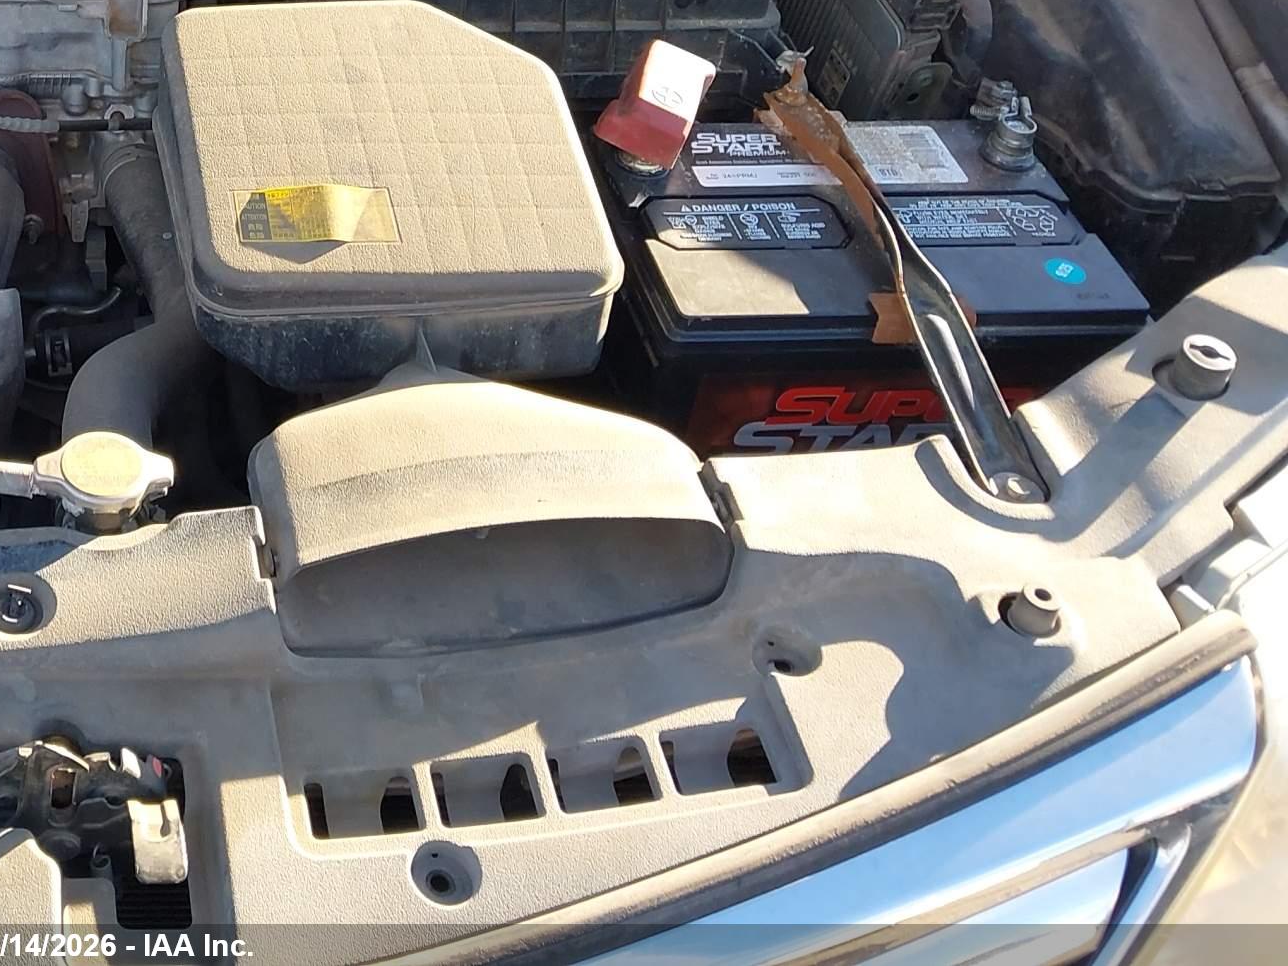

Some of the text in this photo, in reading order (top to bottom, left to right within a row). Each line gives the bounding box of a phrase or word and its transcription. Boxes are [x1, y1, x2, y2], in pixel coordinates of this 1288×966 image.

[696, 132, 777, 143] SUPER
[691, 141, 781, 153] START
[692, 203, 740, 212] DANGER
[751, 202, 796, 211] POISON
